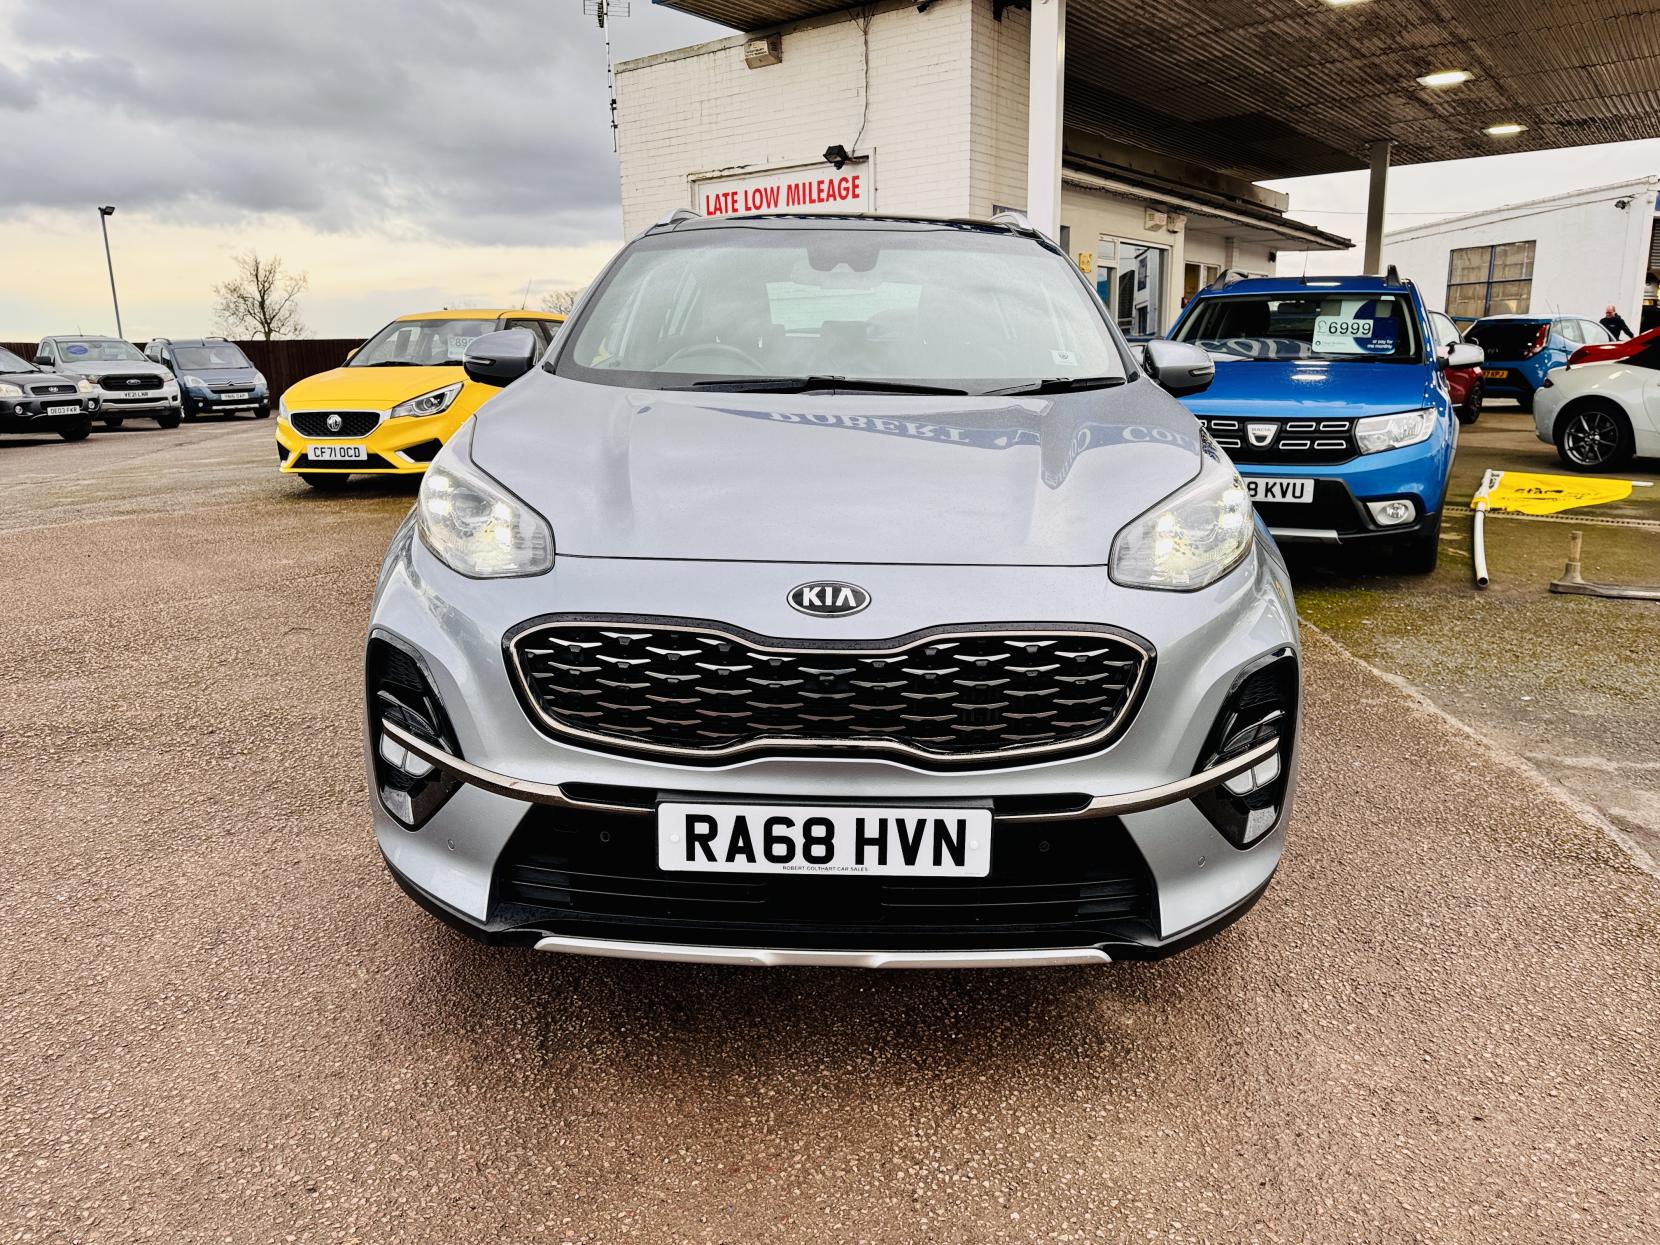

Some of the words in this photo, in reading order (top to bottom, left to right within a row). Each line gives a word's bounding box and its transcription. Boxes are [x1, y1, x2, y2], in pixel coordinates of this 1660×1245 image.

[706, 191, 739, 216] LATE
[744, 185, 780, 213] LOW
[786, 175, 860, 207] MILEAGE
[313, 446, 336, 458] CF71
[339, 446, 360, 458] OCD
[1264, 481, 1305, 499] KVU
[802, 586, 857, 607] KIA
[685, 813, 836, 865] RA68
[855, 817, 967, 867] HVN
